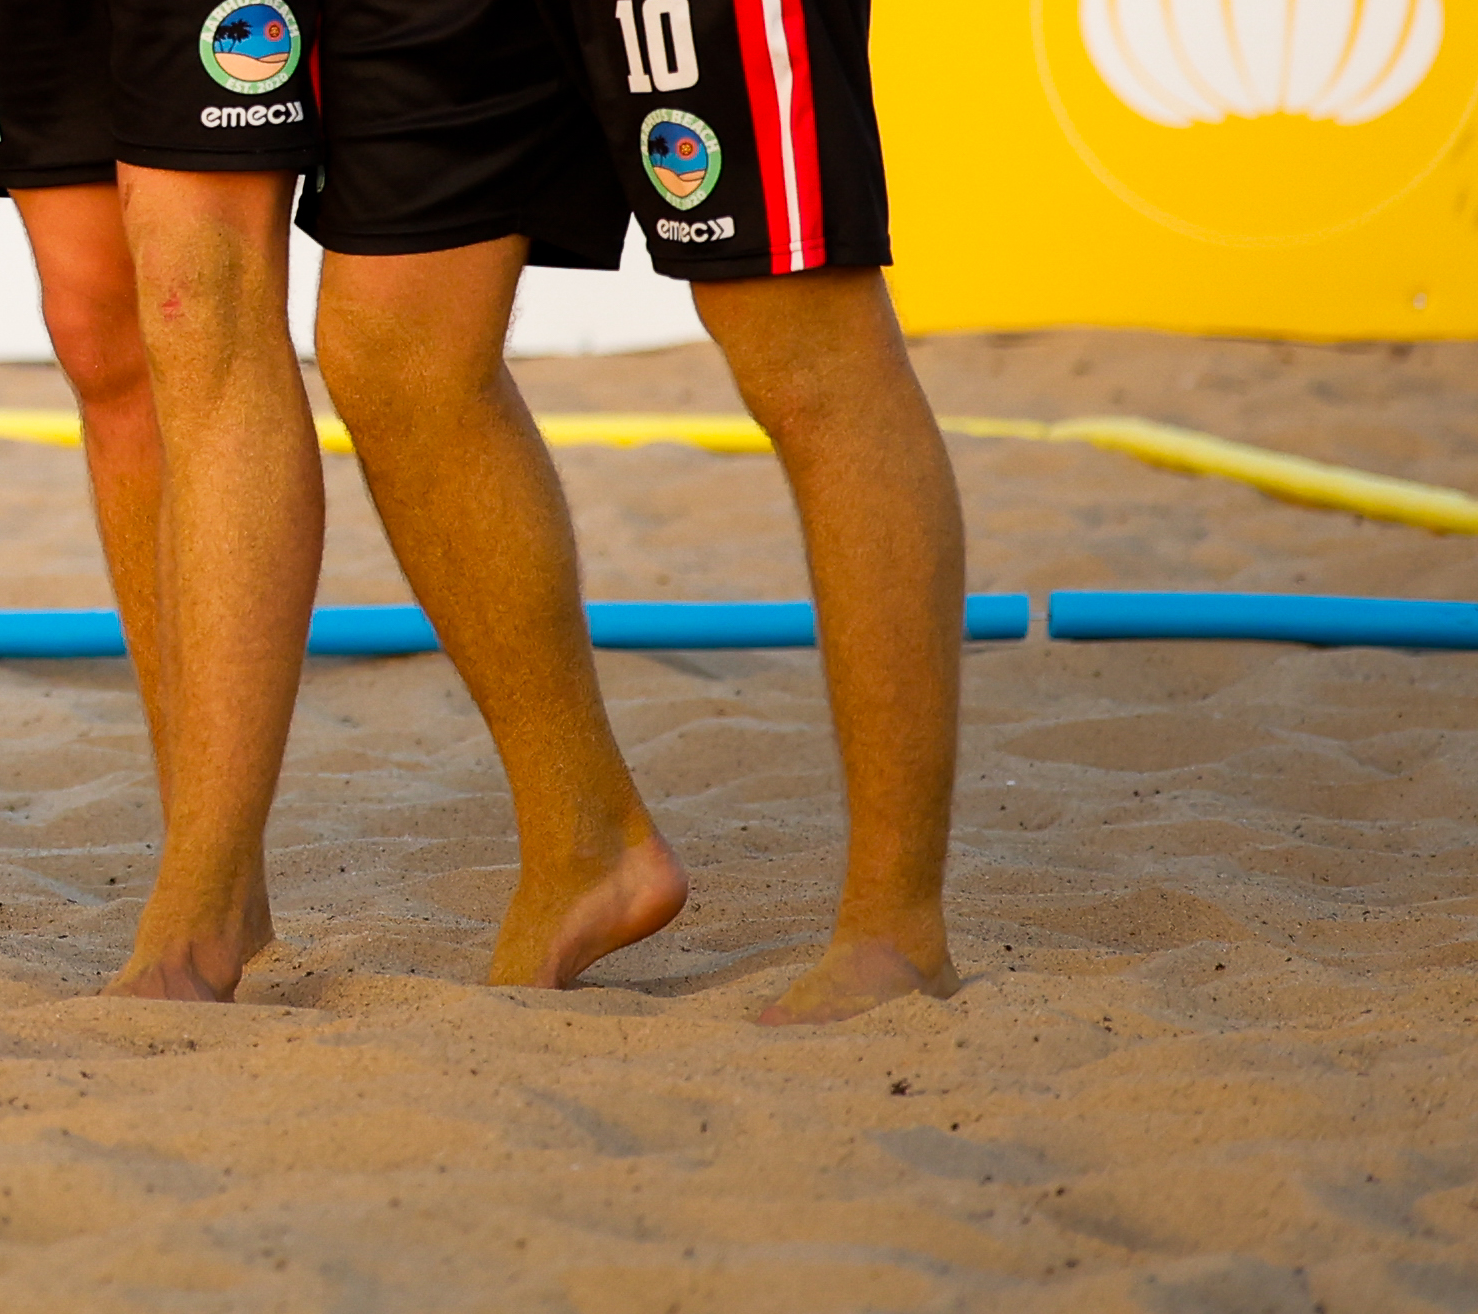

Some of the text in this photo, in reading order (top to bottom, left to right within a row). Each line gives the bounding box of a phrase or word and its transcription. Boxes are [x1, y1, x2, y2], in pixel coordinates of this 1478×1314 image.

[225, 72, 290, 95] EST. 2020
[201, 104, 286, 129] emec
[672, 109, 721, 153] BEACH
